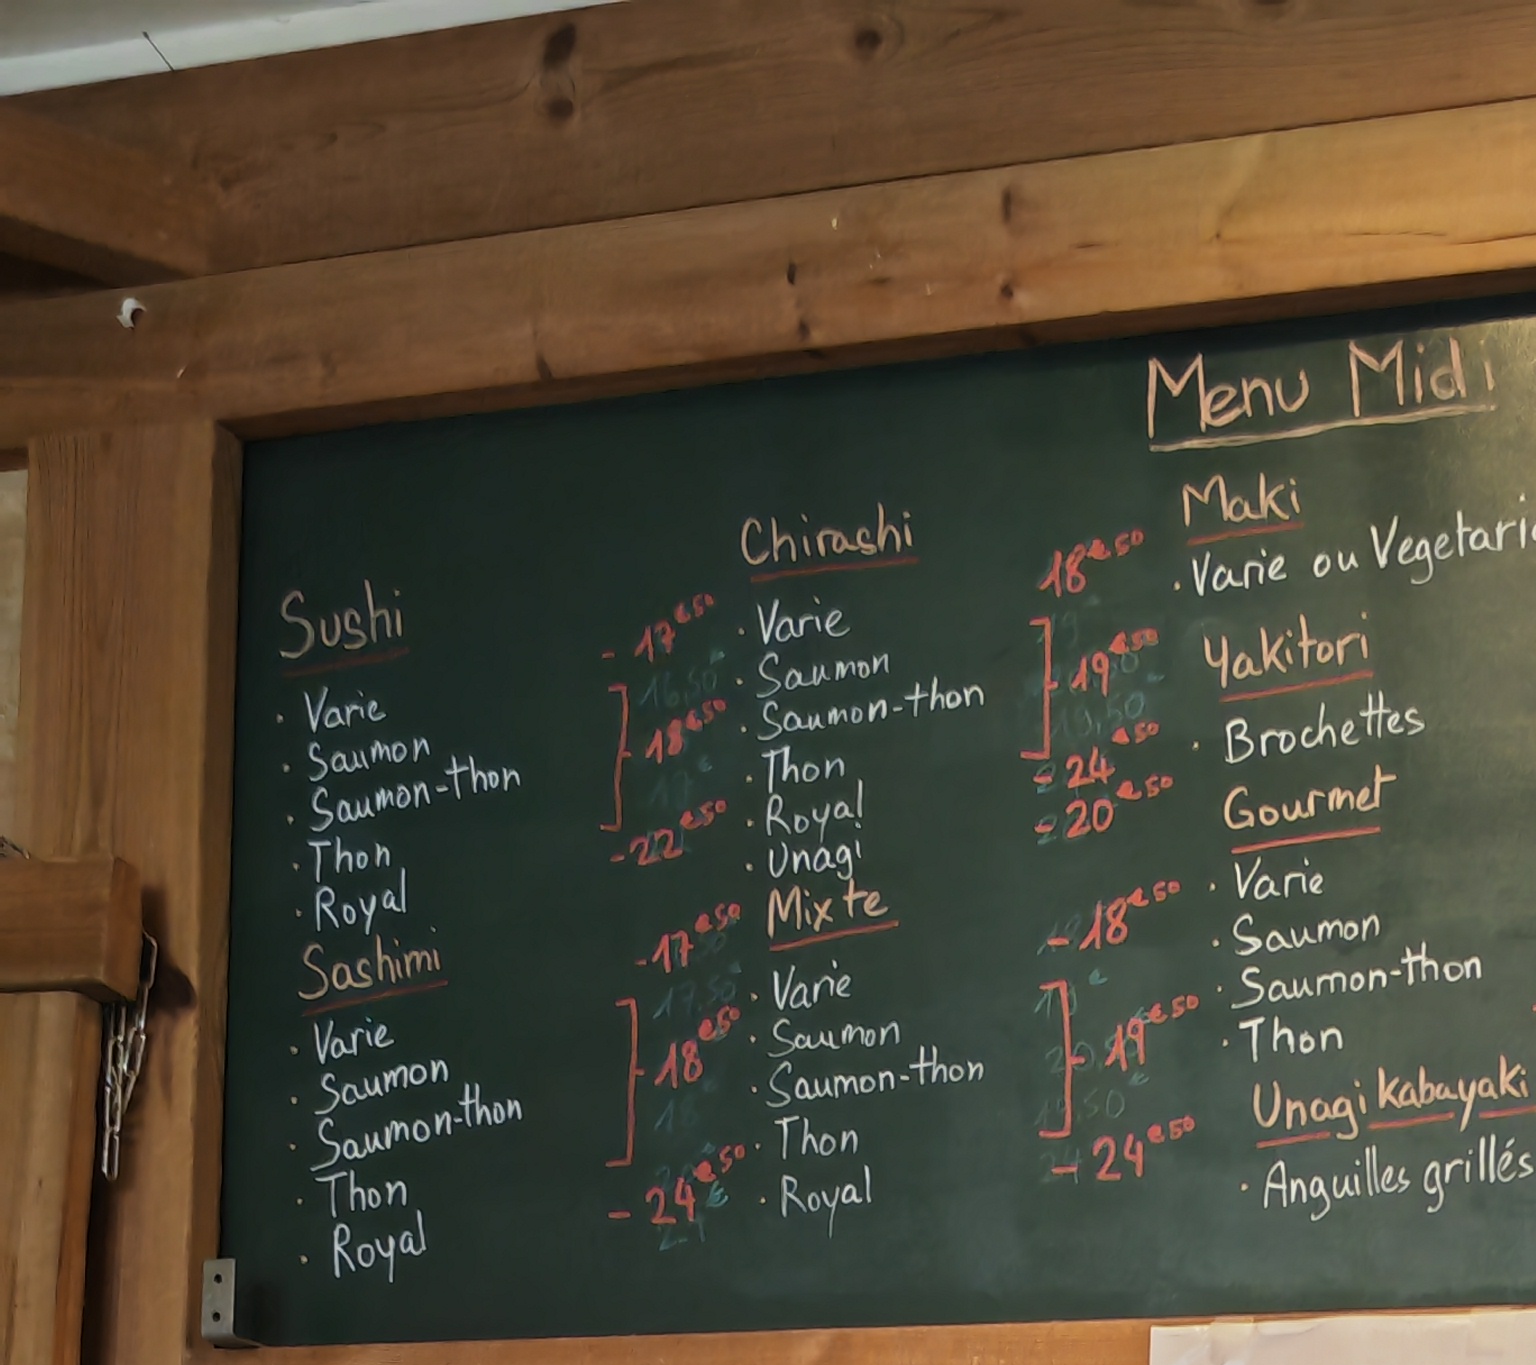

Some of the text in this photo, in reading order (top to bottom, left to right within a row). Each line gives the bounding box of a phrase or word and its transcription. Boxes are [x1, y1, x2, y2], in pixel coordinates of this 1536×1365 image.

[1147, 353, 1310, 439] Menu
[1349, 336, 1495, 417] Midi
[1183, 473, 1301, 526] Maki
[1314, 547, 1358, 579] ou
[280, 579, 403, 658] Sushi
[757, 595, 850, 645] Varie
[756, 652, 889, 698] Saumon
[1204, 612, 1368, 688] Yakitori
[304, 687, 387, 733] Varie
[1225, 691, 1425, 763] Brochettes
[309, 737, 430, 782] Saumon
[762, 745, 845, 793] Thon
[767, 779, 863, 842] Royal
[1224, 765, 1397, 829] Gourmet
[307, 836, 390, 882] Thon
[1235, 857, 1324, 900] Varie
[315, 867, 407, 936] Royal
[768, 878, 888, 938] Mixte
[1232, 914, 1380, 955] Saumon
[298, 928, 441, 1000] Sashimi
[772, 960, 851, 1010] Varie
[314, 1016, 395, 1065] Varie
[767, 1018, 900, 1058] Saumon
[1238, 1016, 1343, 1062] Thon
[315, 1059, 448, 1115] Saumon
[1253, 1079, 1367, 1140] Unagi
[775, 1116, 858, 1159] Thon
[315, 1169, 407, 1218] Thon
[780, 1165, 872, 1239] Royal
[1263, 1134, 1534, 1221] Anguilles grillés
[334, 1209, 427, 1283] Royal
